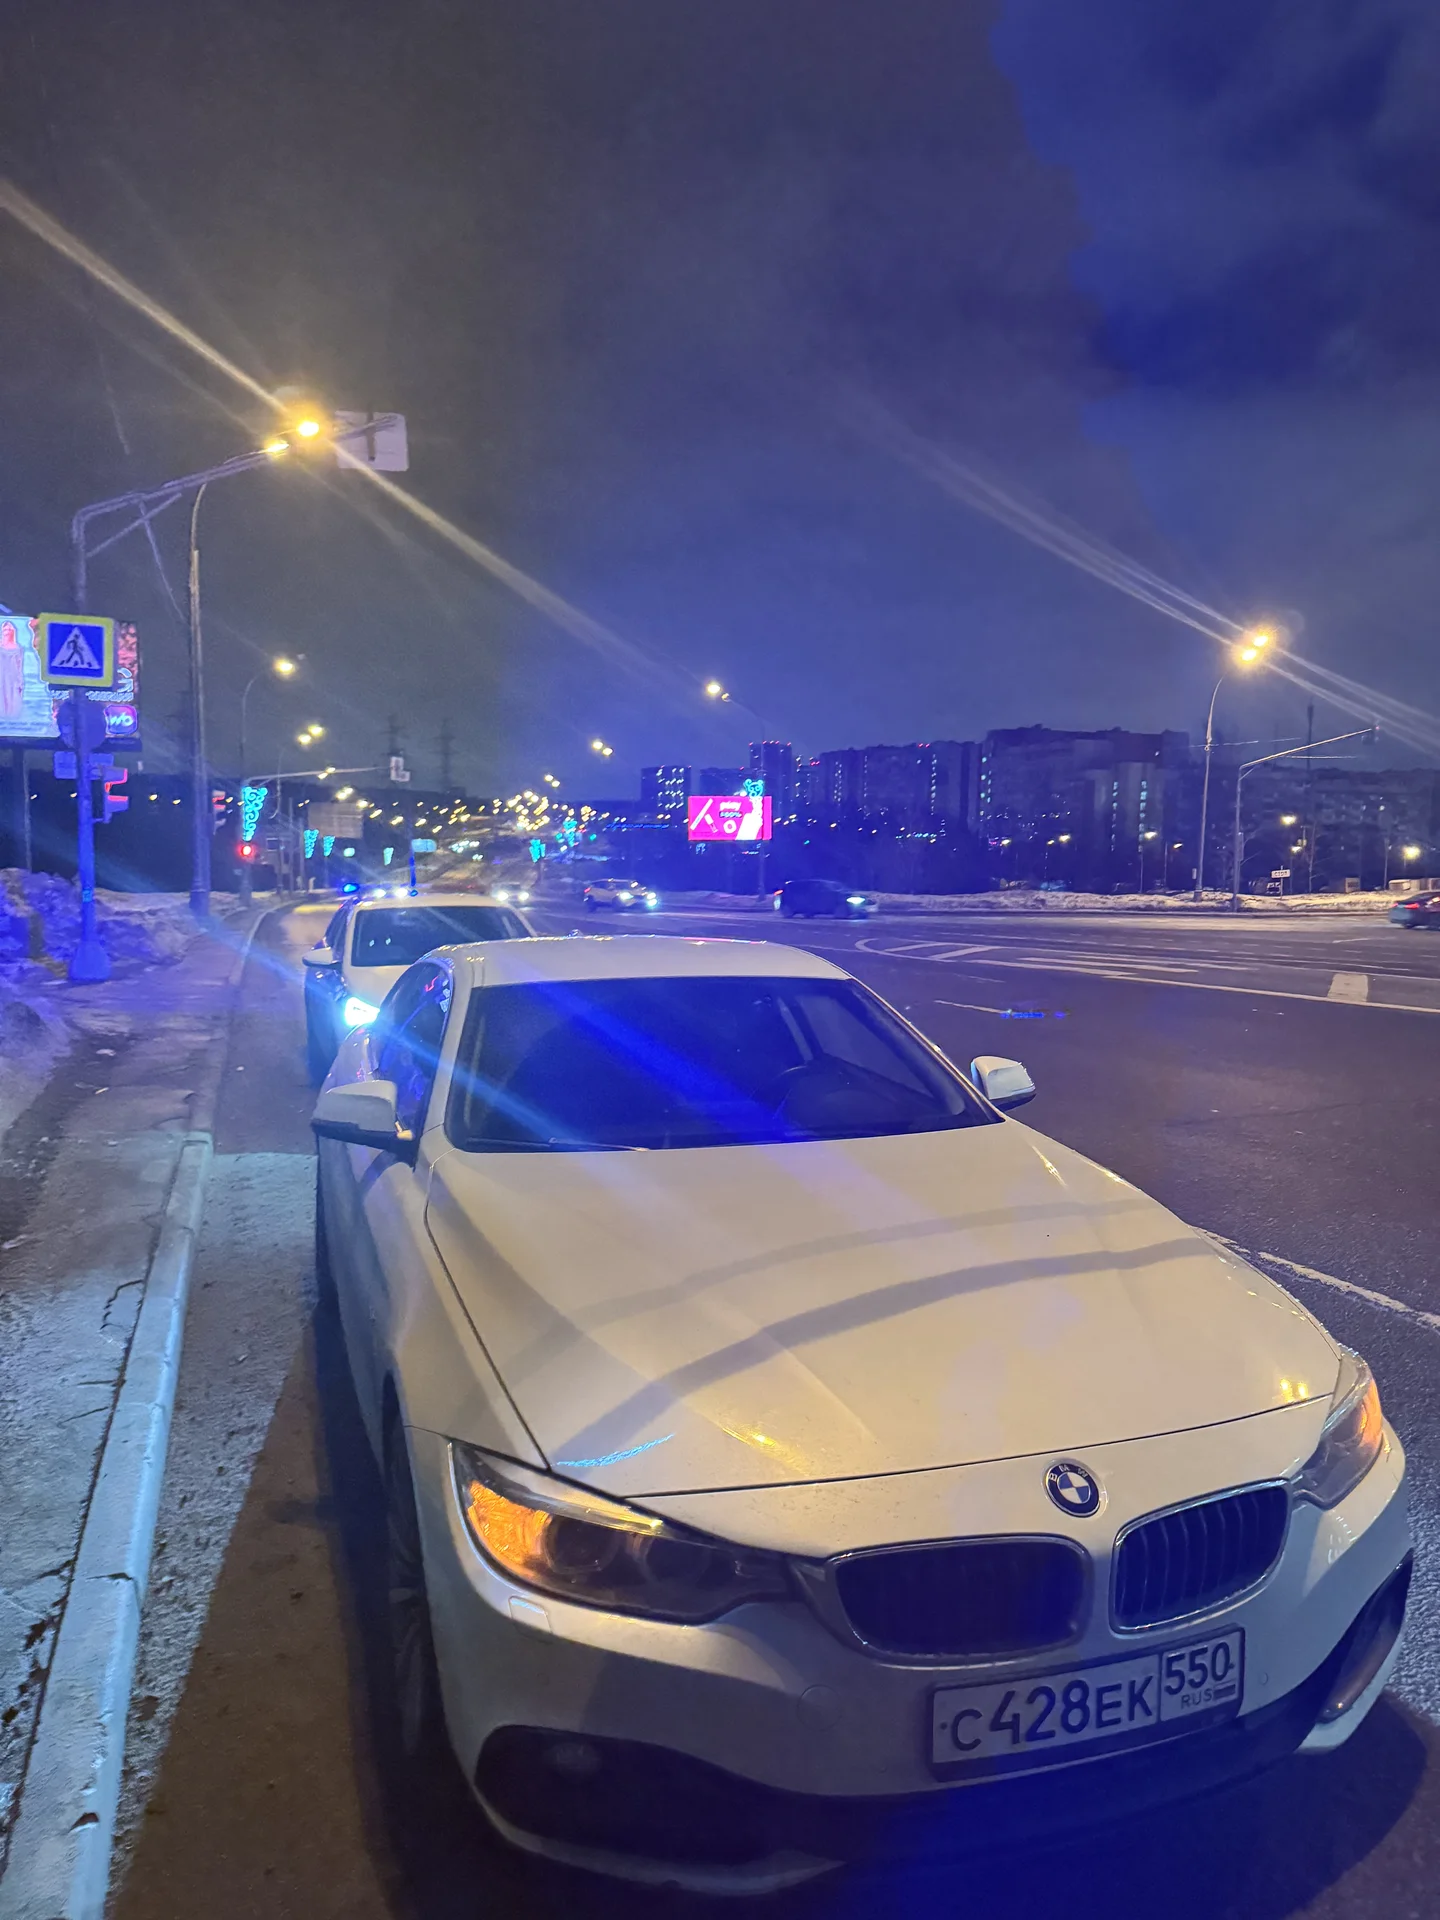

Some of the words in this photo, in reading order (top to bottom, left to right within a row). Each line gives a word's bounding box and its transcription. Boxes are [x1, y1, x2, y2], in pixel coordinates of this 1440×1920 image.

[1048, 1463, 1089, 1482] BMW
[952, 1675, 1155, 1751] С428ЕК
[1164, 1641, 1231, 1696] 550
[1180, 1687, 1214, 1710] RUS
